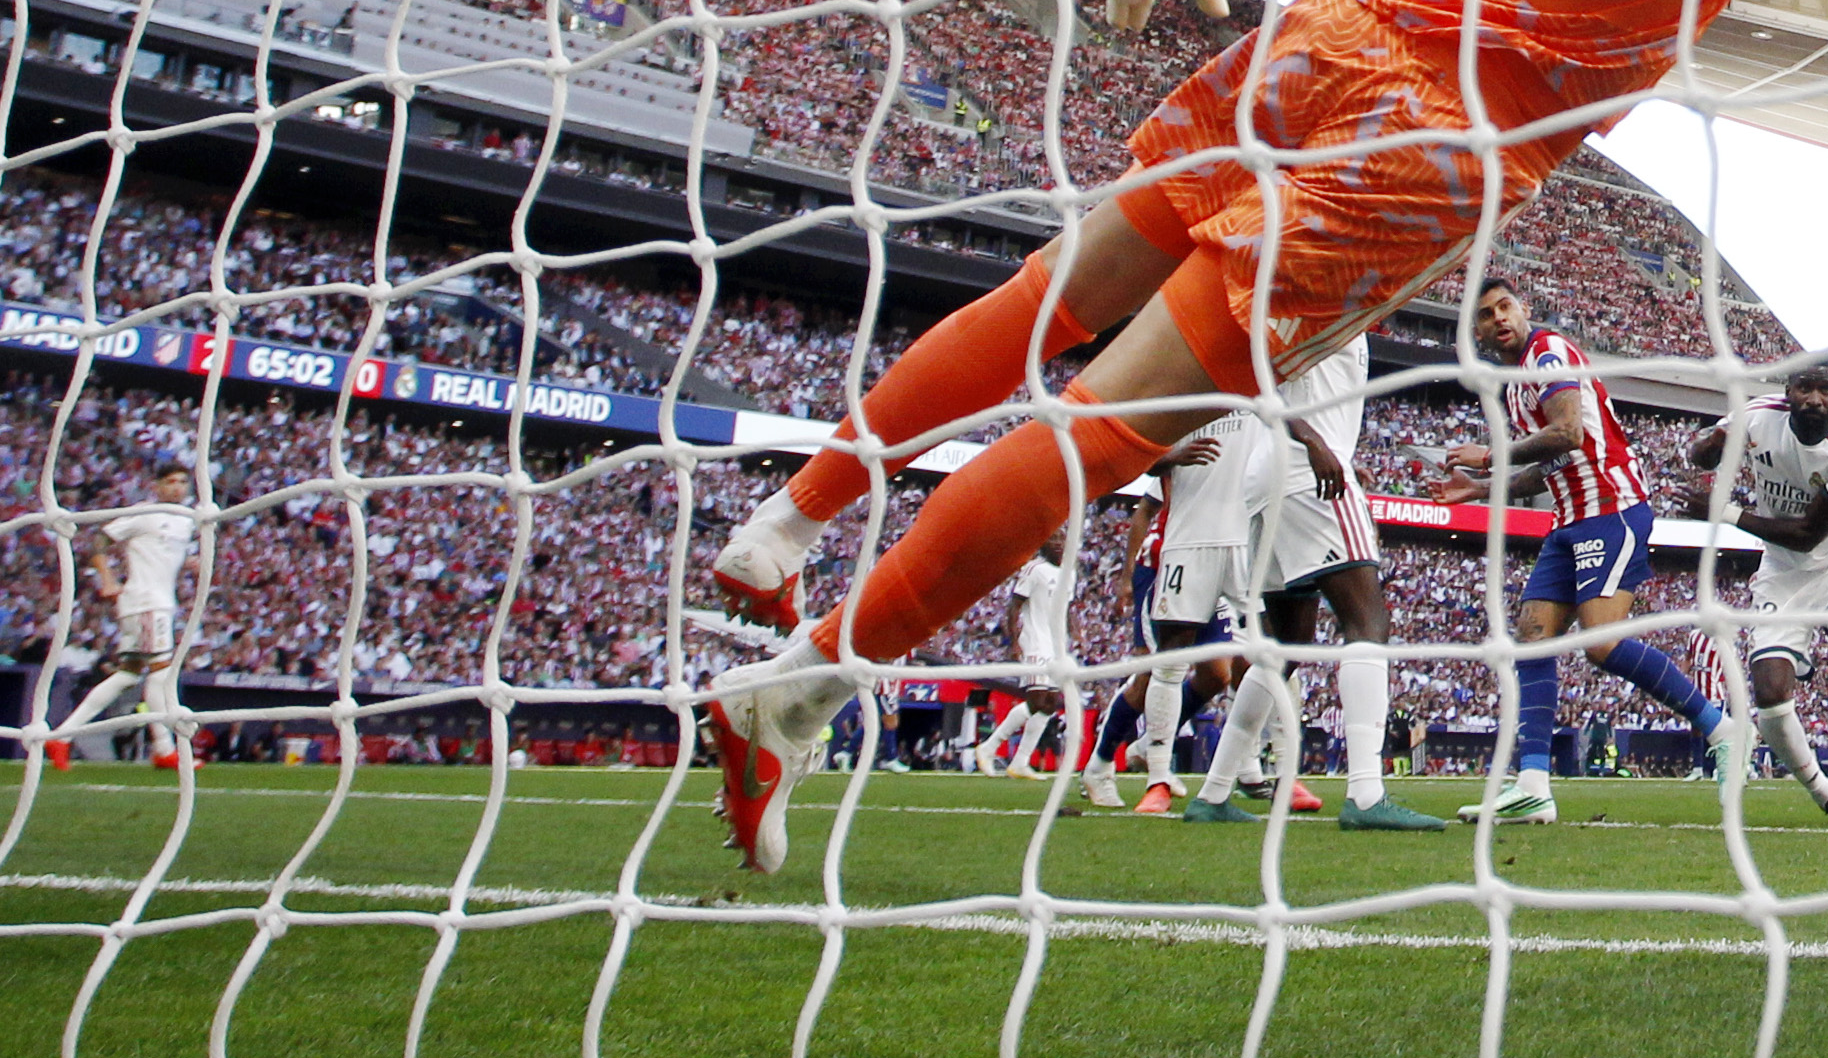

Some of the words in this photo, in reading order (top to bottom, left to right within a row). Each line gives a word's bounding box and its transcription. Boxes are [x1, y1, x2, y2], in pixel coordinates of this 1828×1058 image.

[1, 309, 141, 358] MADID
[247, 346, 336, 387] 65:02
[355, 362, 379, 393] 0
[431, 371, 503, 409] REAL
[504, 382, 612, 423] MADRID
[1386, 502, 1452, 525] MADRID
[1780, 500, 1806, 514] BETT
[1163, 562, 1184, 594] 14
